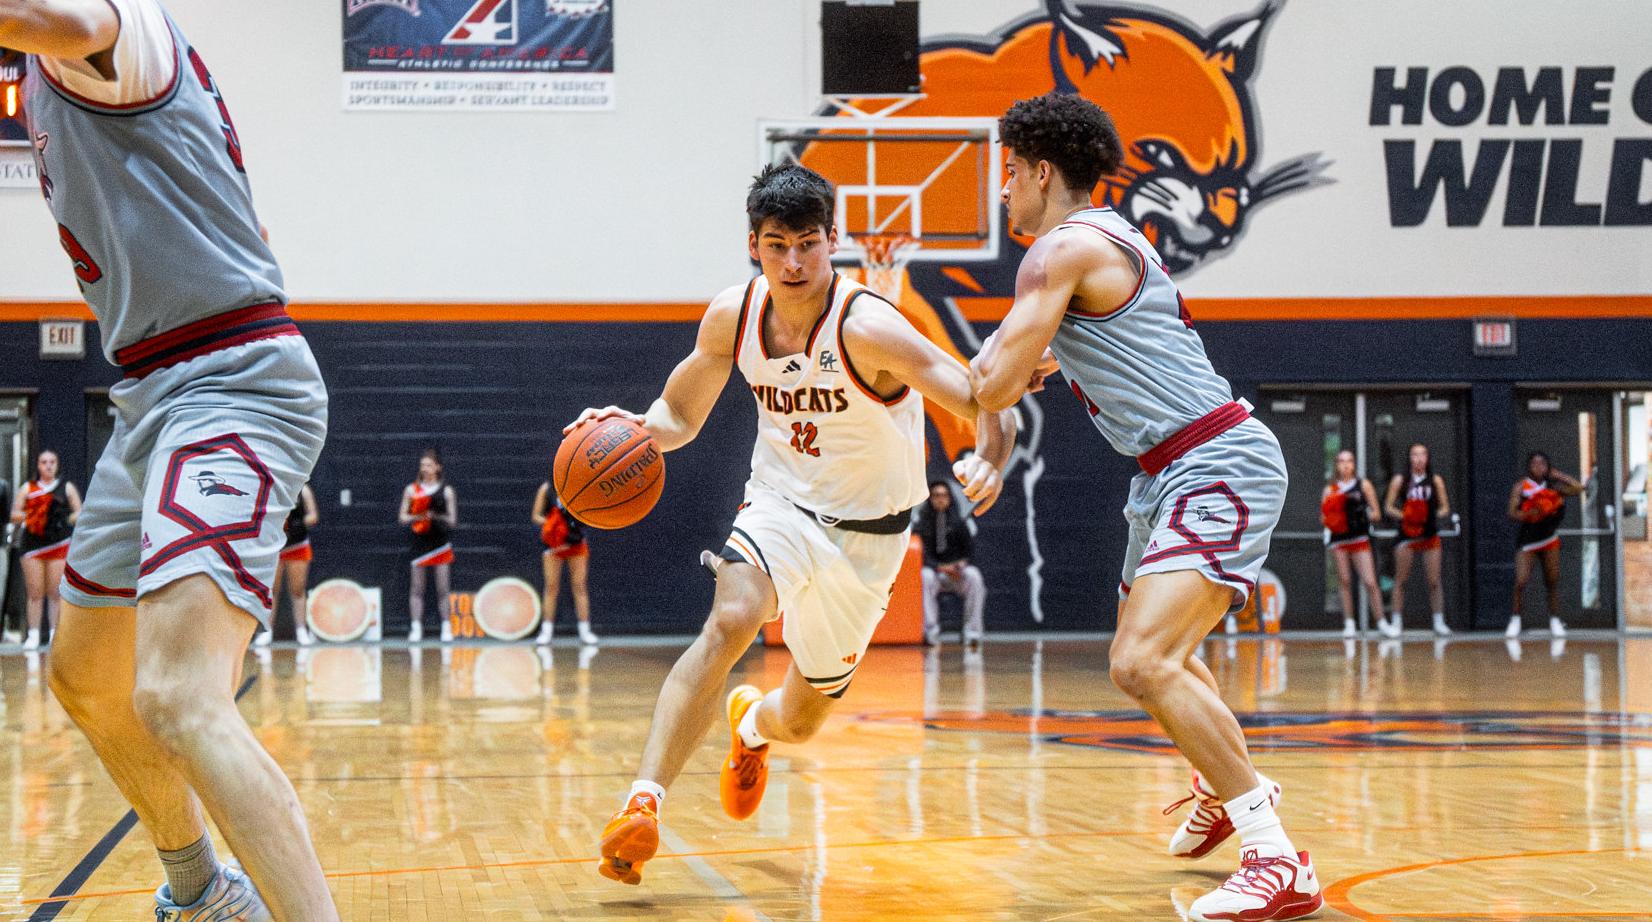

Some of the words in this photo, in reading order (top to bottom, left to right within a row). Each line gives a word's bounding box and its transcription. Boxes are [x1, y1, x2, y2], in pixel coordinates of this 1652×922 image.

[348, 93, 457, 105] SPORTSMANSHIP
[470, 93, 527, 105] SERVANT
[531, 93, 609, 105] LEADERSHIP
[349, 80, 418, 91] INTEGRITY
[433, 80, 536, 91] RESPONSIBILITY
[551, 80, 606, 91] RESPECT
[1369, 66, 1615, 127] HOME
[49, 326, 75, 346] EXIT
[752, 385, 849, 415] WILDCATS
[790, 421, 821, 457] 12
[598, 443, 659, 497] SPALDING
